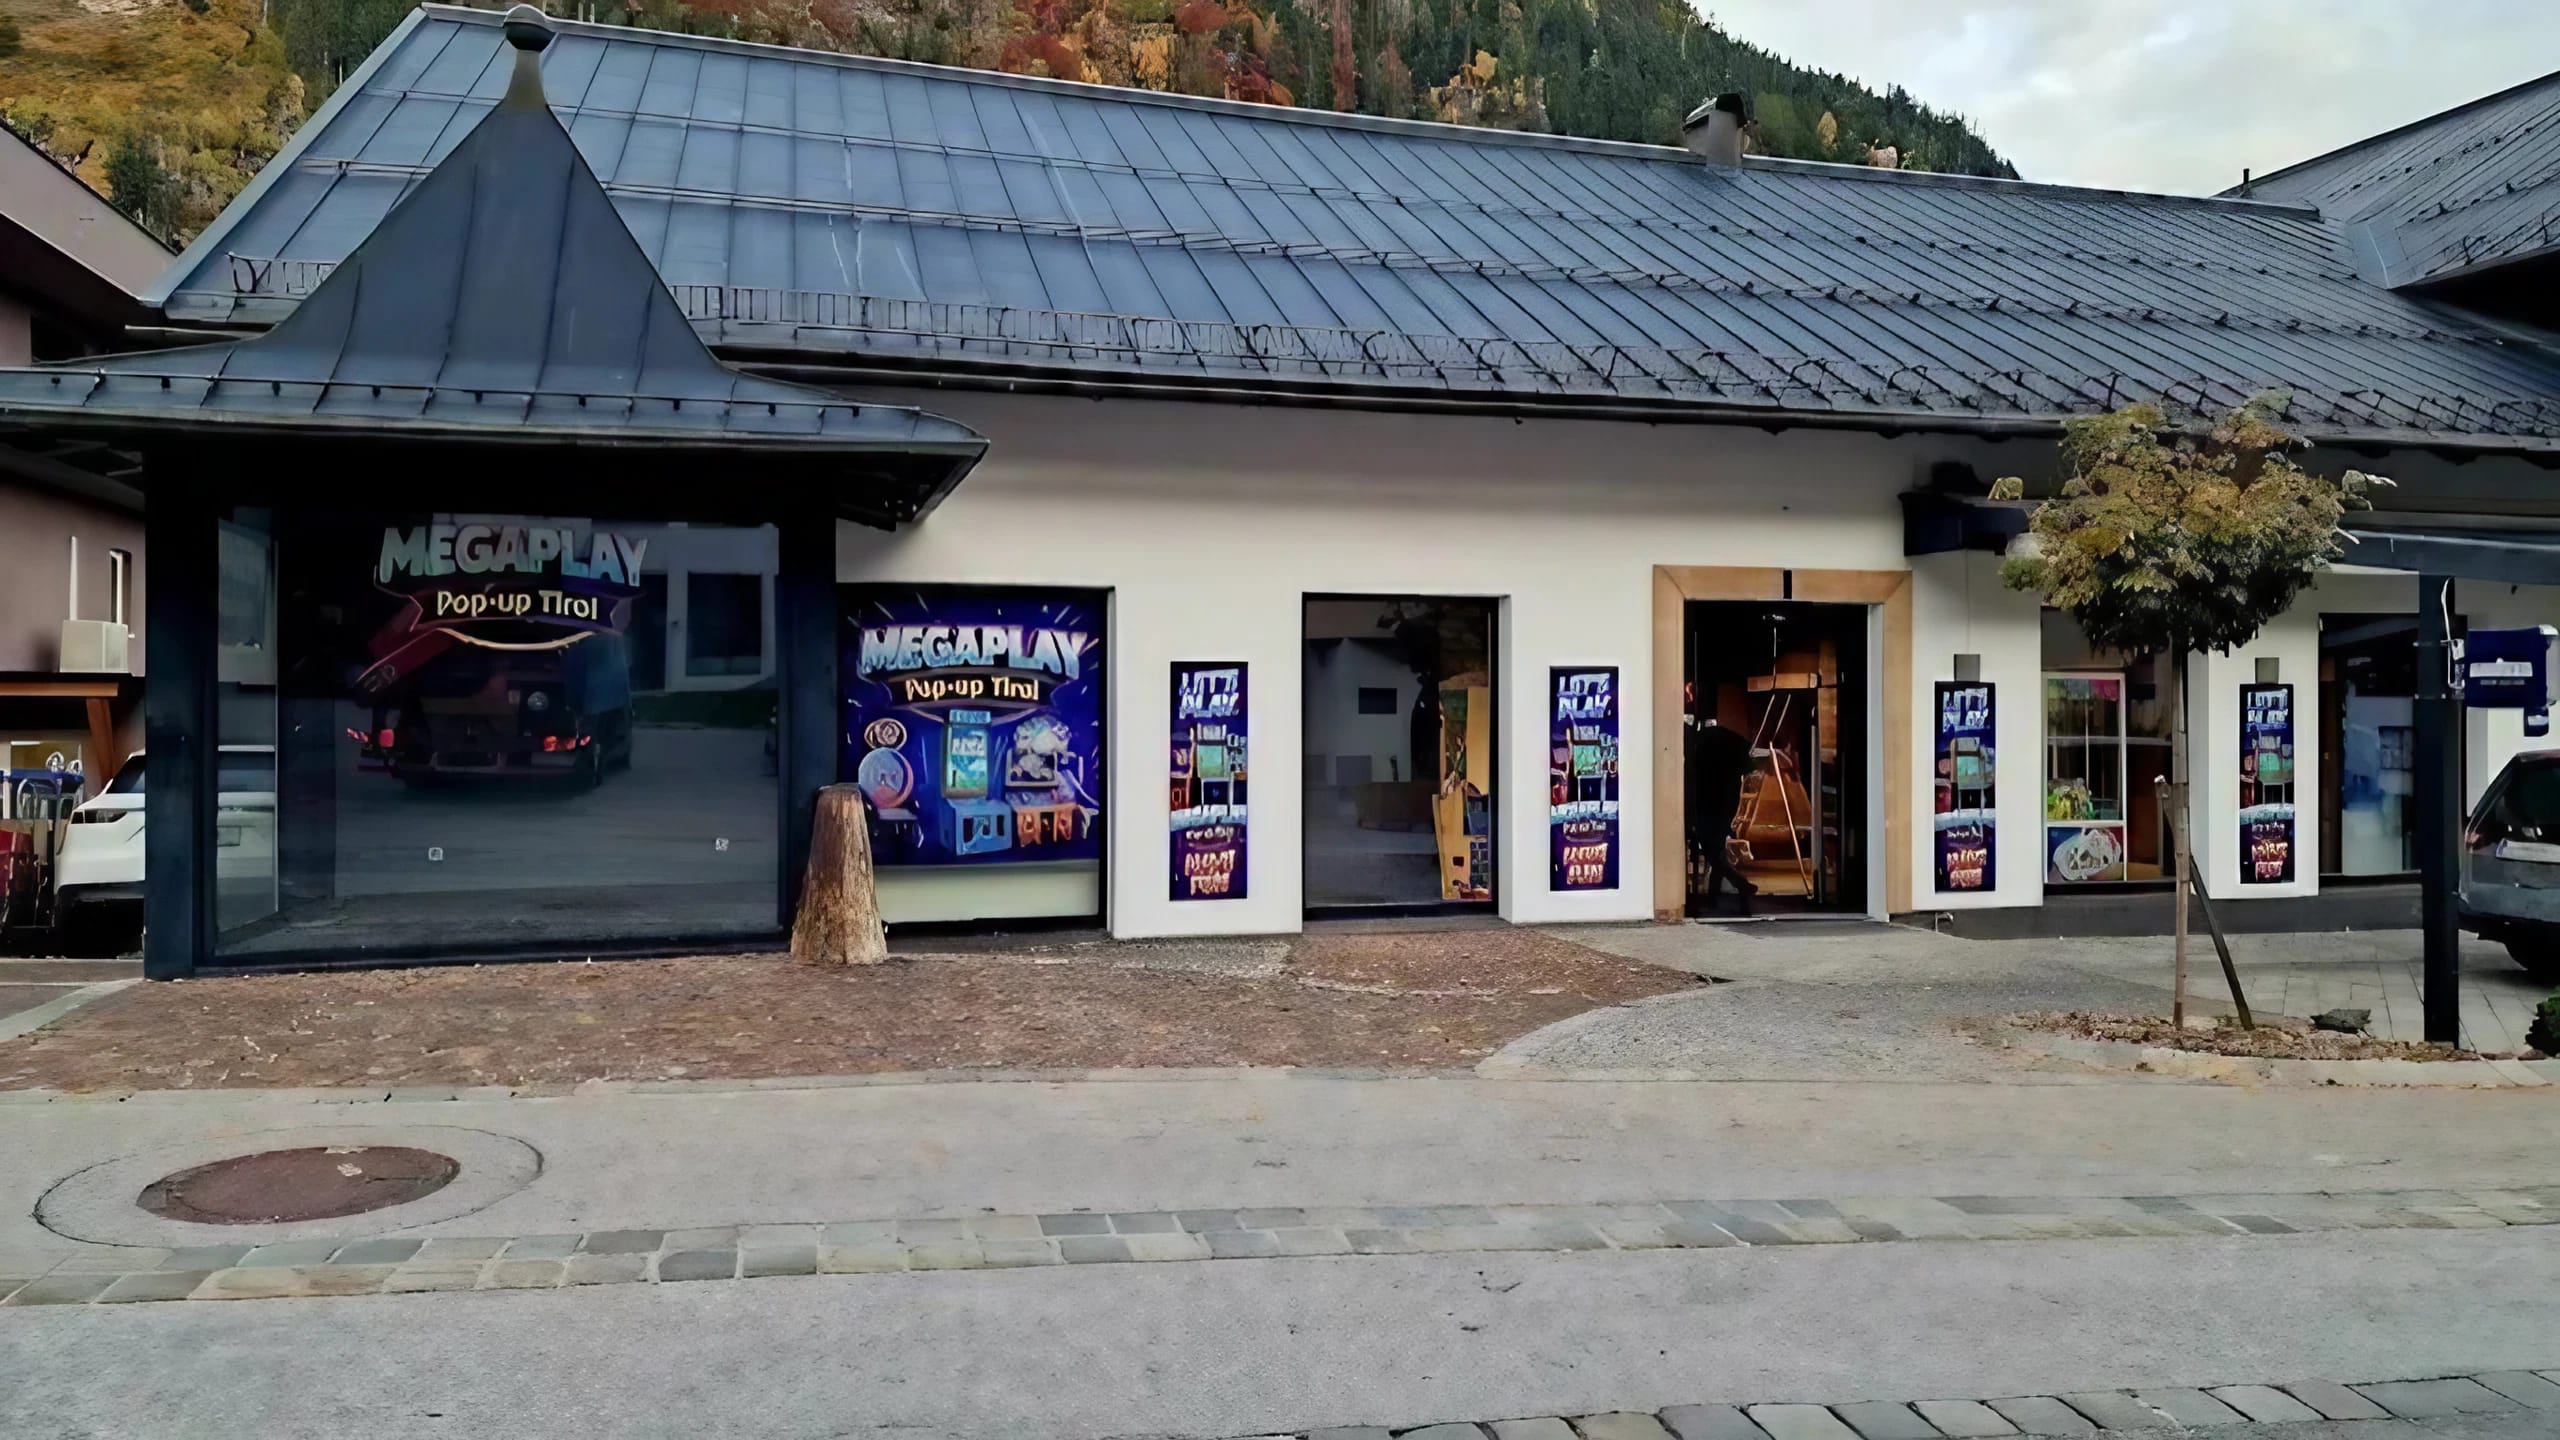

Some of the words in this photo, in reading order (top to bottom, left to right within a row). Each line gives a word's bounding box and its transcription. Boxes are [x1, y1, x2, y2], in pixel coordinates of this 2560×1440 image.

[379, 525, 648, 587] MEGAPLAY
[538, 589, 598, 620] Tirol
[861, 625, 1088, 680] MEGAPLAY
